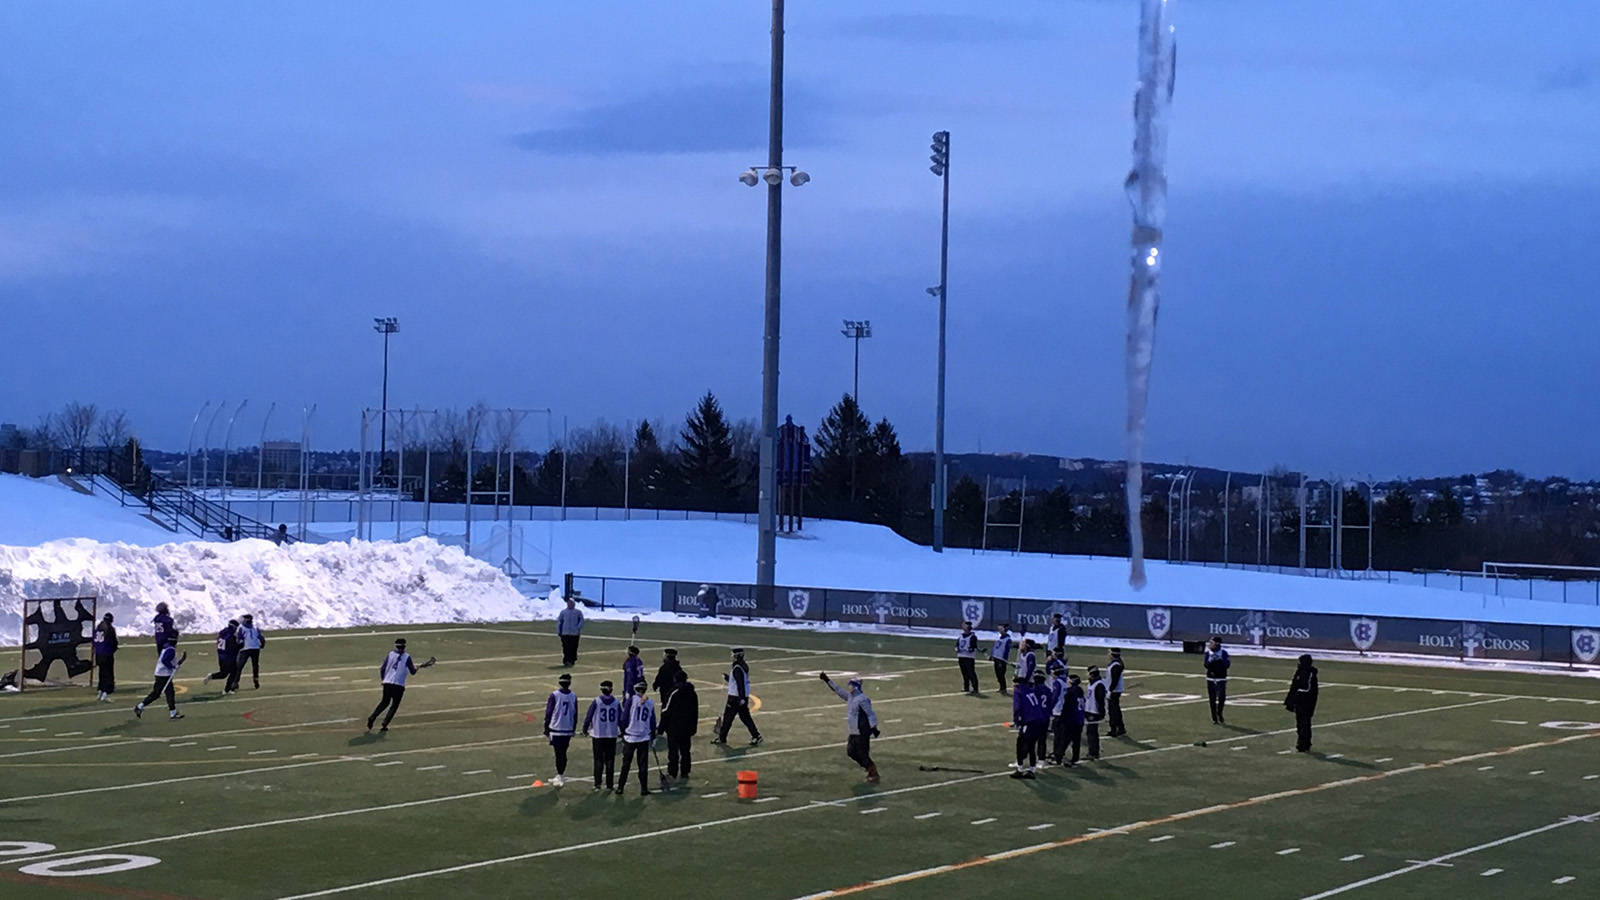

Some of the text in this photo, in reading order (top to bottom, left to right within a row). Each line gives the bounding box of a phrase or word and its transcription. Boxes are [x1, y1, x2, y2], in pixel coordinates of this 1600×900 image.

[677, 594, 758, 609] HOL CROSS
[842, 604, 928, 618] HOLY CROSS
[1070, 616, 1110, 628] CROSS
[1209, 623, 1310, 639] HOLY CROSS
[1419, 634, 1530, 650] HOLY CROSS
[562, 701, 569, 716] 7
[600, 708, 616, 722] 38
[636, 706, 649, 722] 16
